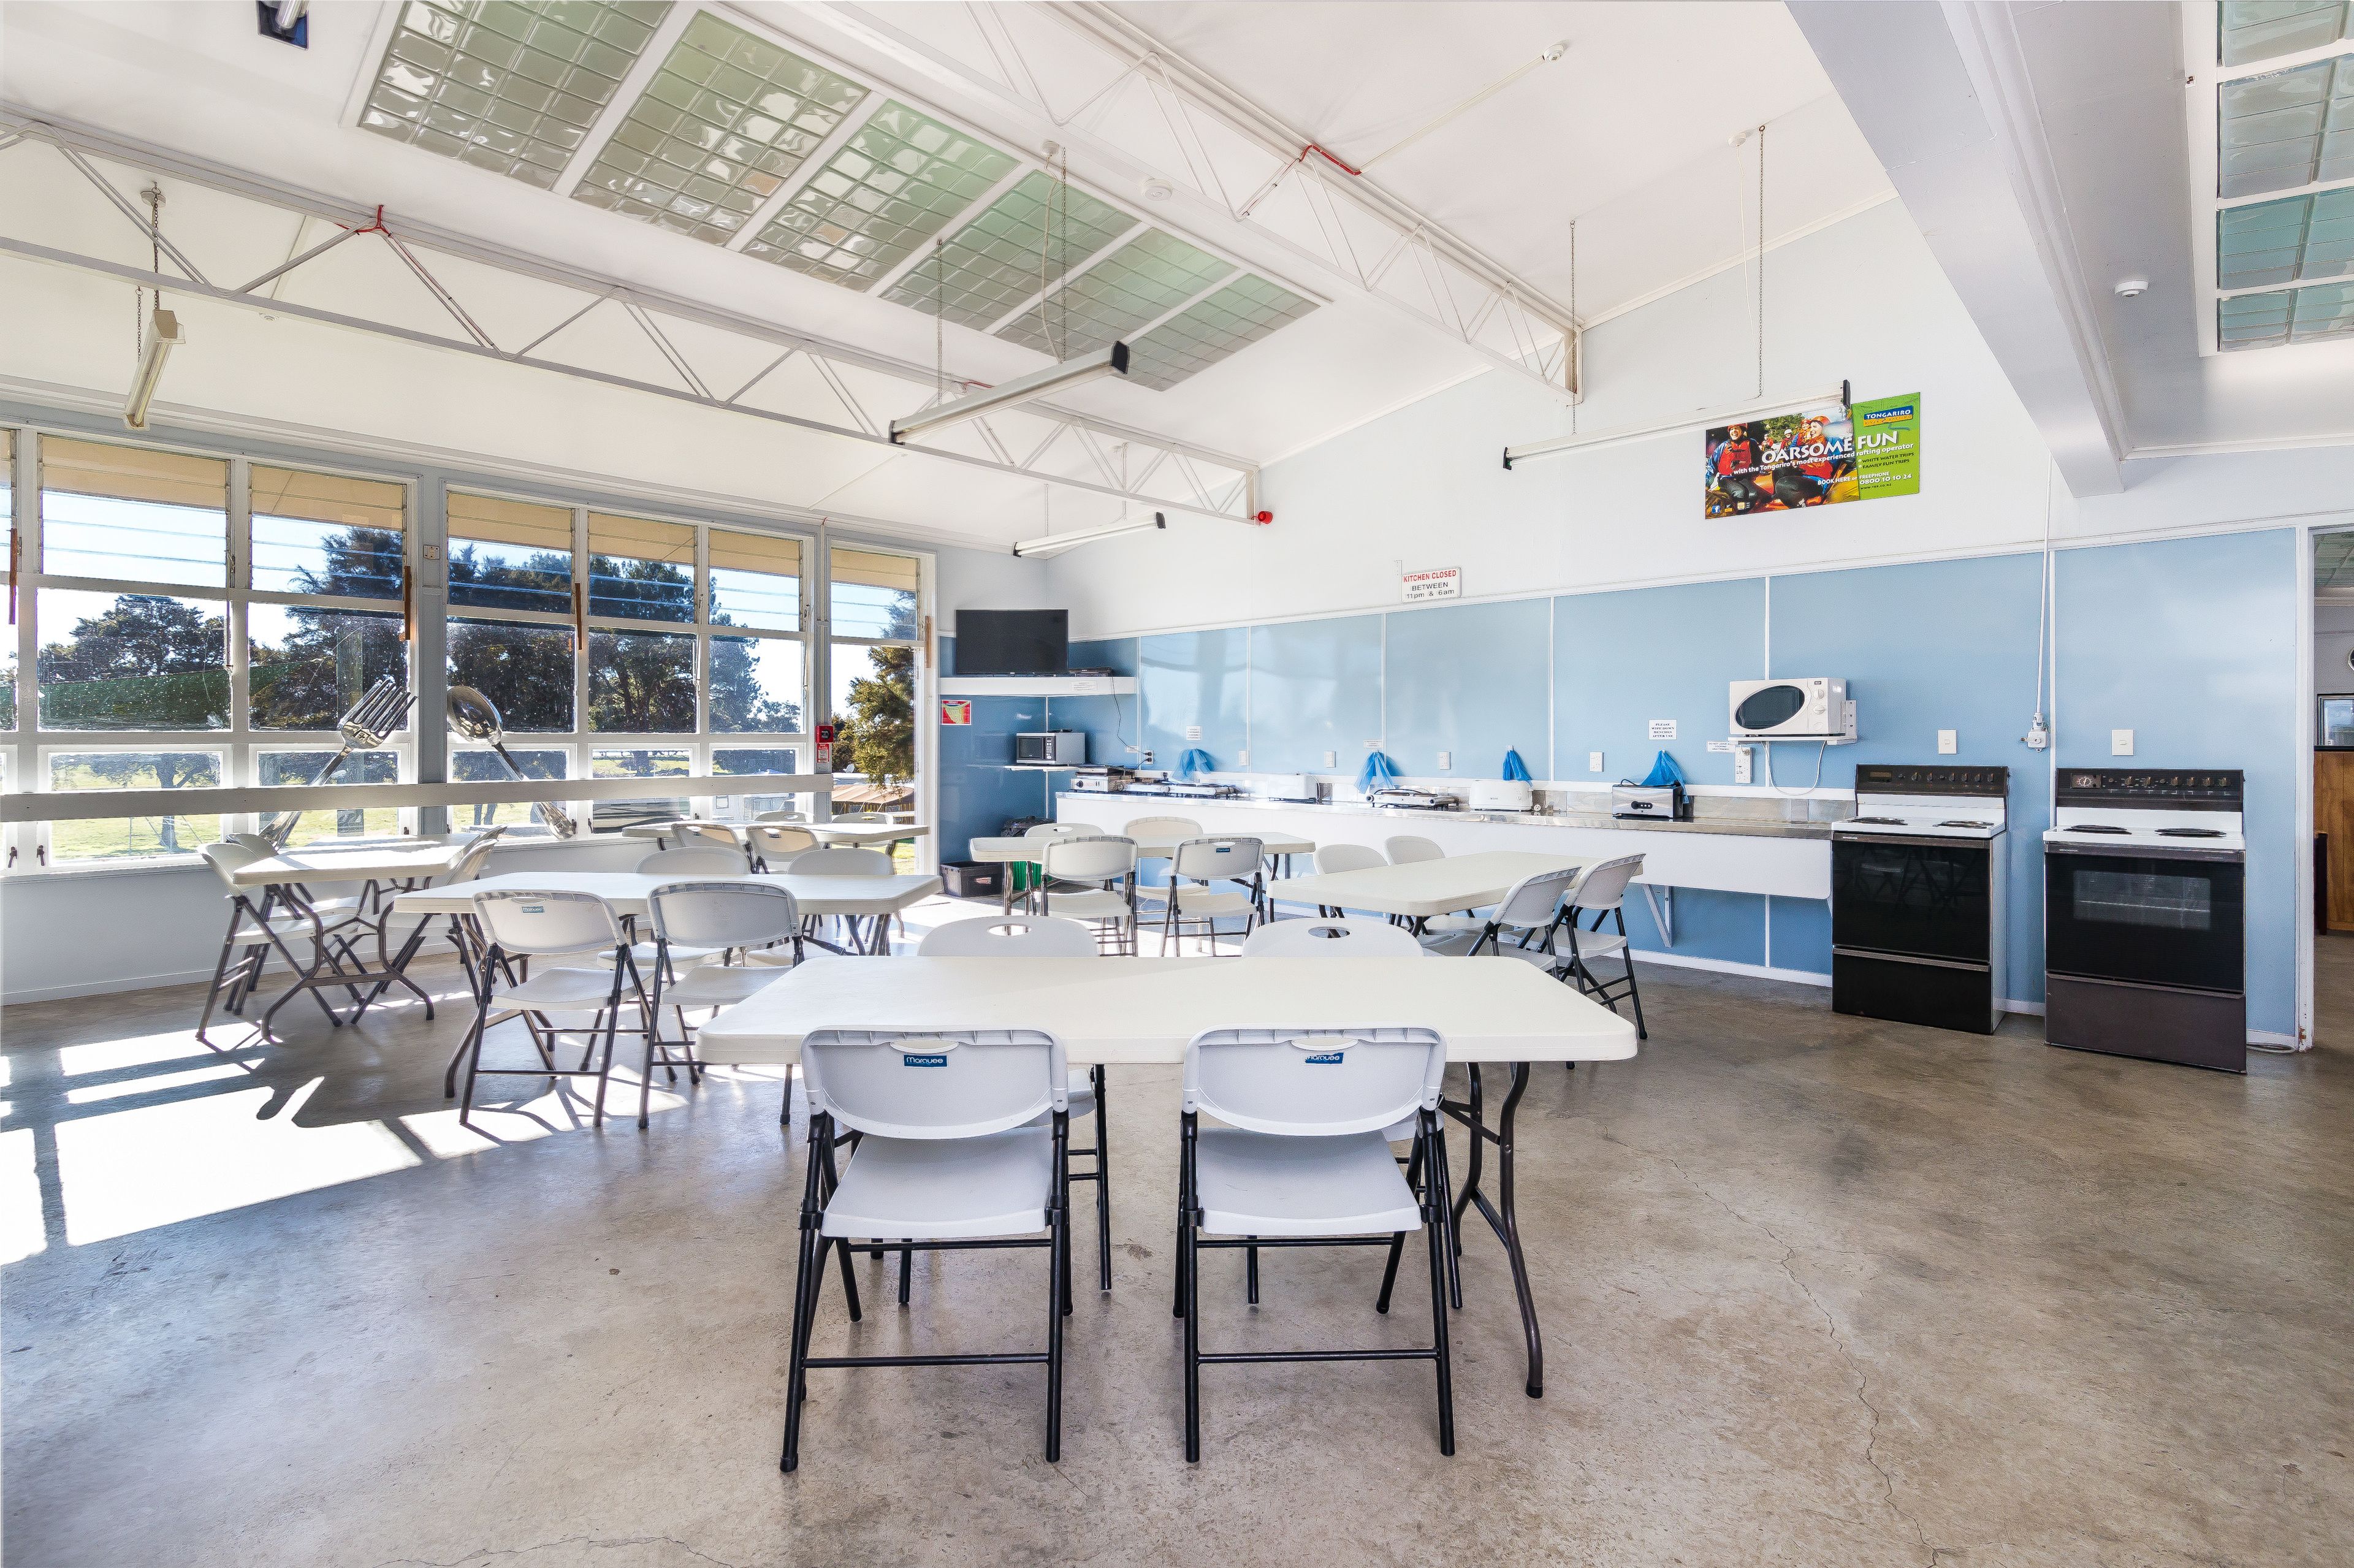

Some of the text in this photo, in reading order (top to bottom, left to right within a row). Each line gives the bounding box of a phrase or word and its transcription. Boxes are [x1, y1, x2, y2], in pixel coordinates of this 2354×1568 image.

[1866, 409, 1911, 419] TONGARIRO
[1761, 430, 1897, 464] OARSOME FUN
[1760, 461, 1796, 471] Tongariro's
[1796, 457, 1813, 466] most
[1813, 452, 1855, 465] experienced
[1881, 443, 1914, 453] operator
[1403, 570, 1457, 583] KITCHEN CLOSED
[1412, 582, 1449, 591] BETWEEN
